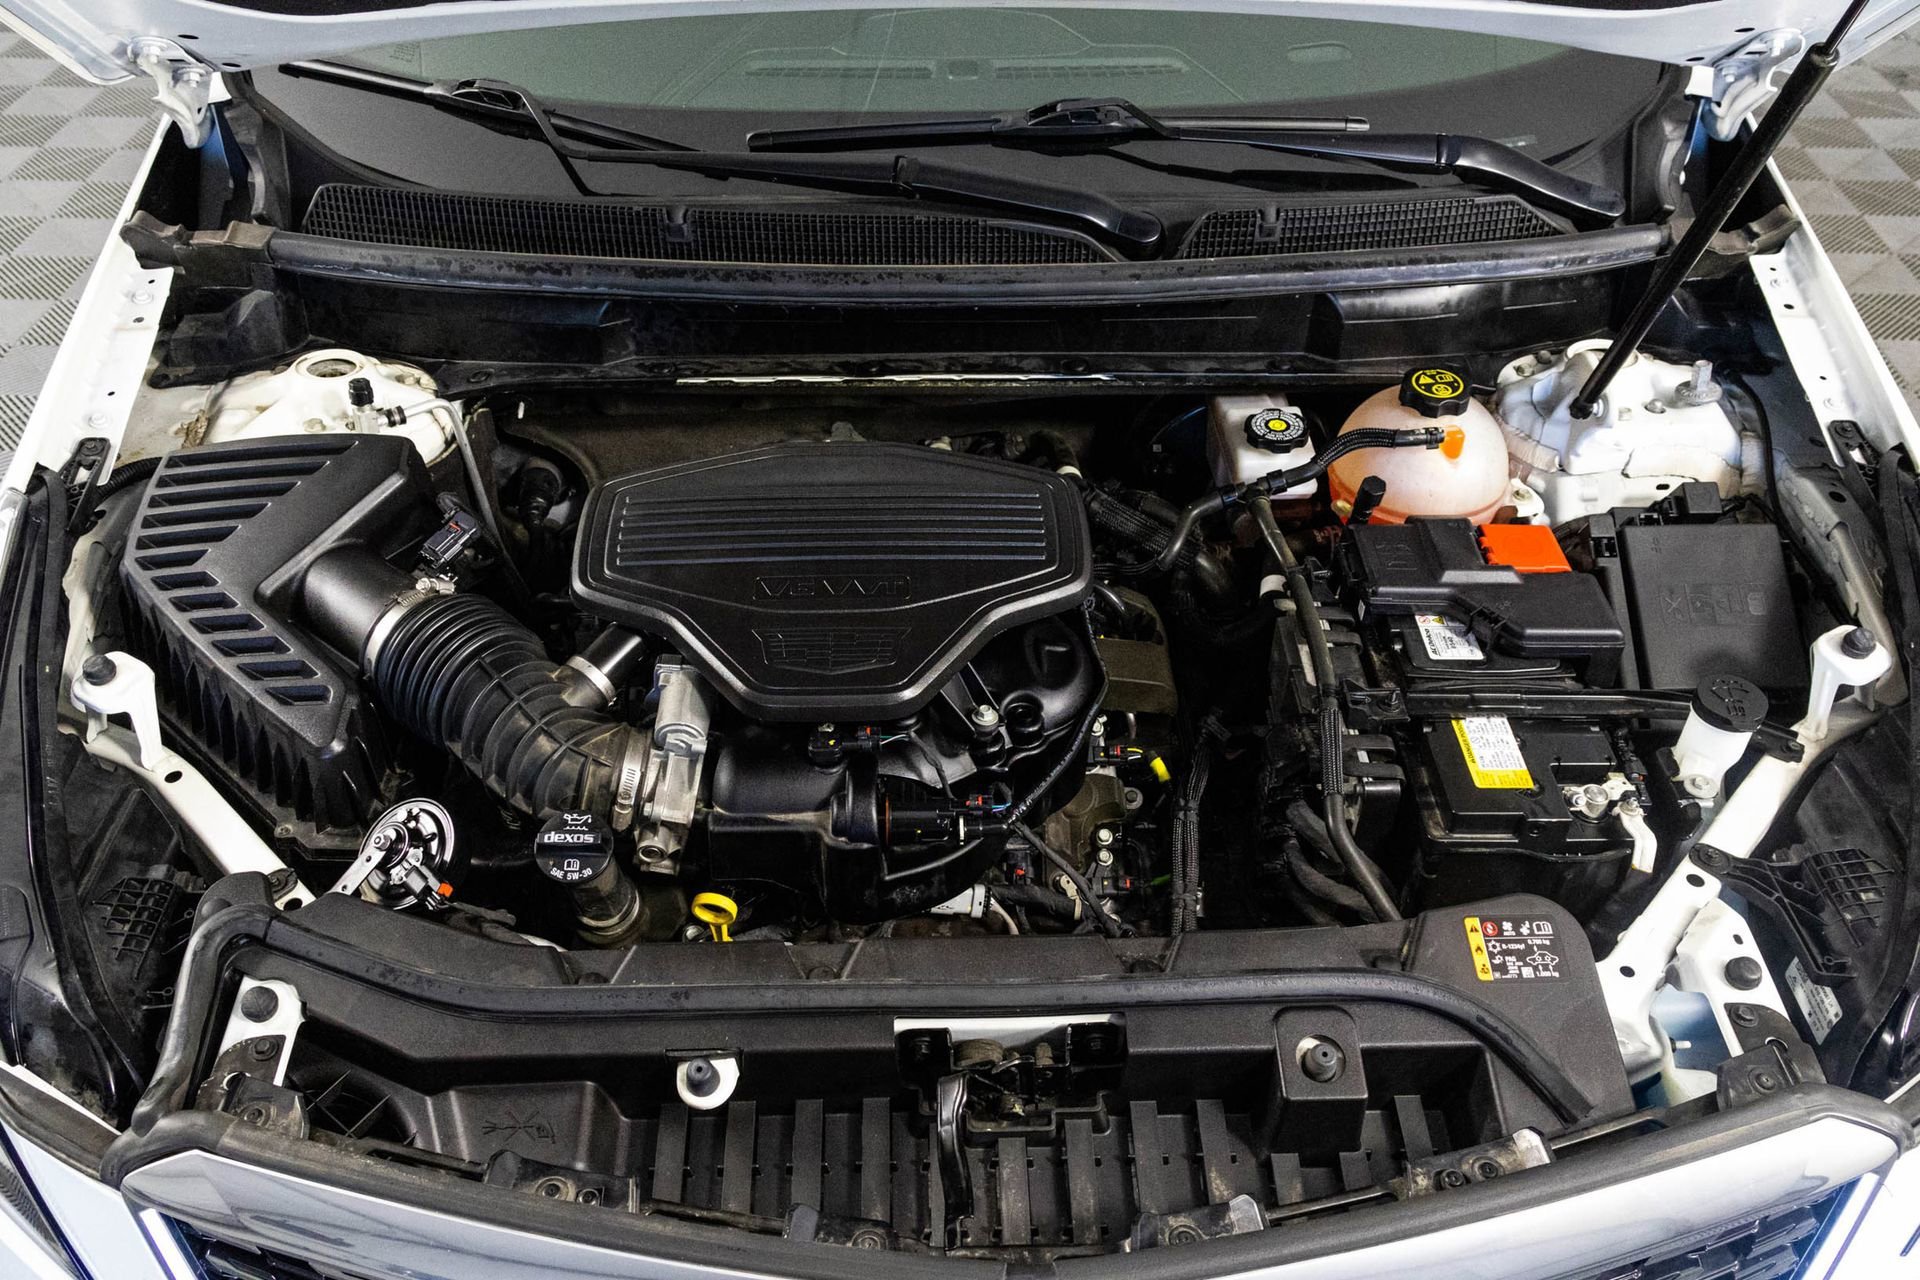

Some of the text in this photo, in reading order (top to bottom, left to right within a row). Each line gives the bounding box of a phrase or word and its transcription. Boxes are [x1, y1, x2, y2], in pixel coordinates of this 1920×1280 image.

[544, 831, 596, 844] dexos
[550, 867, 593, 880] SAE 5W-30
